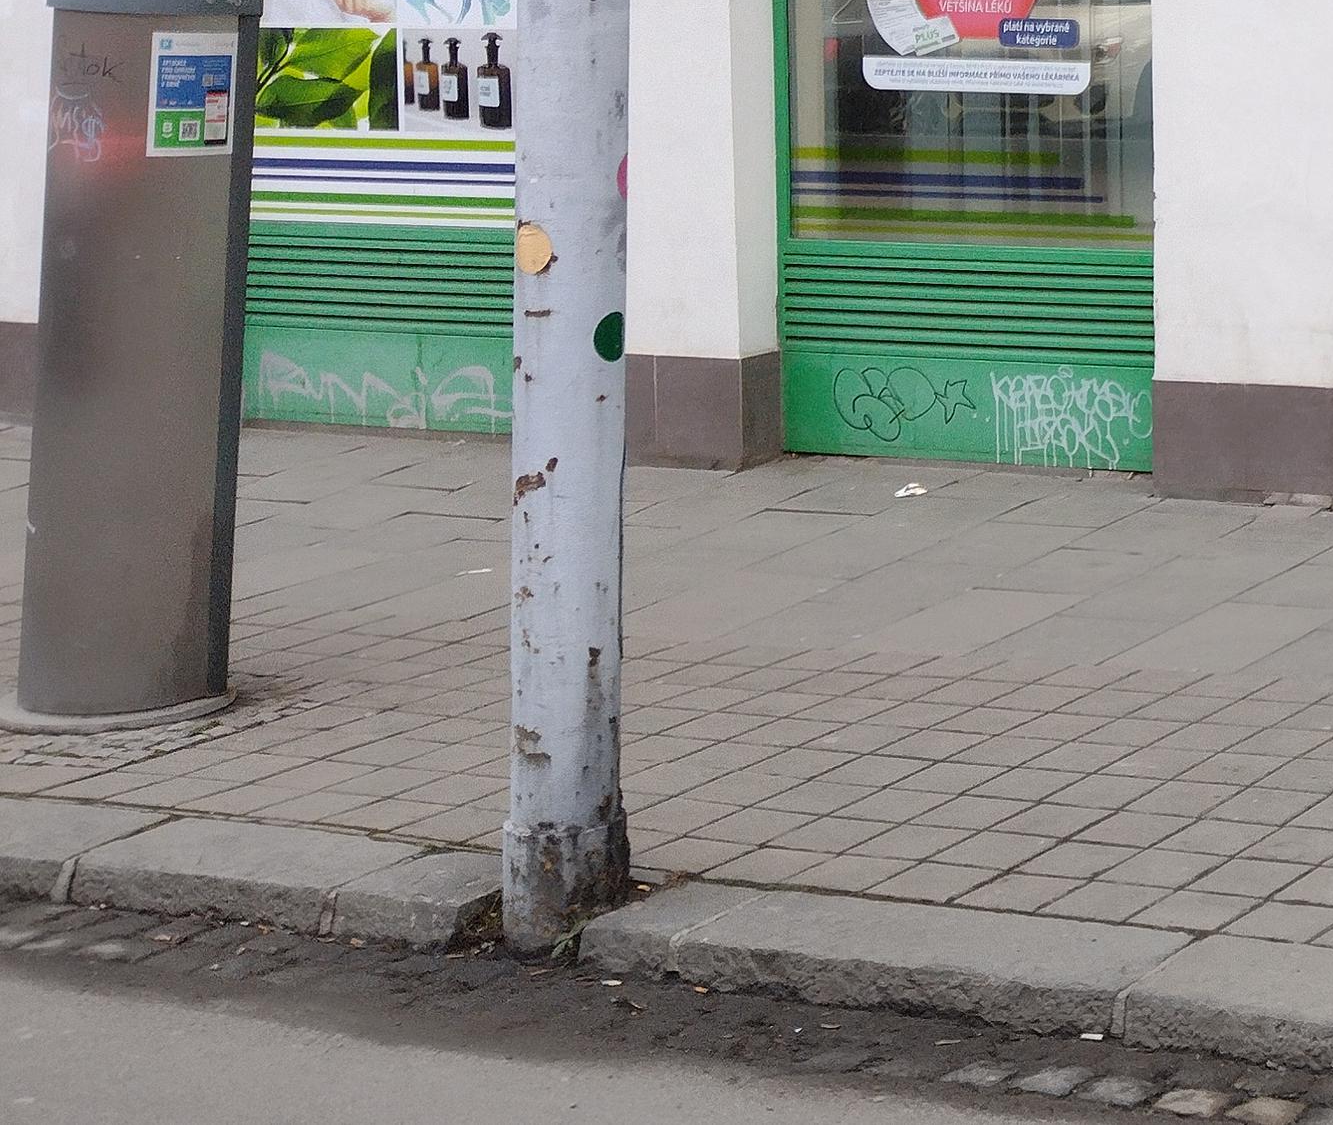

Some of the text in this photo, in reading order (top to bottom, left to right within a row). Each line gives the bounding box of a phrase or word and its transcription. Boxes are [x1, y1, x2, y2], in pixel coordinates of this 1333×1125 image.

[985, 0, 1013, 14] LÉKŮ
[1003, 20, 1070, 34] platí na vybrané
[1016, 33, 1058, 47] kategorie
